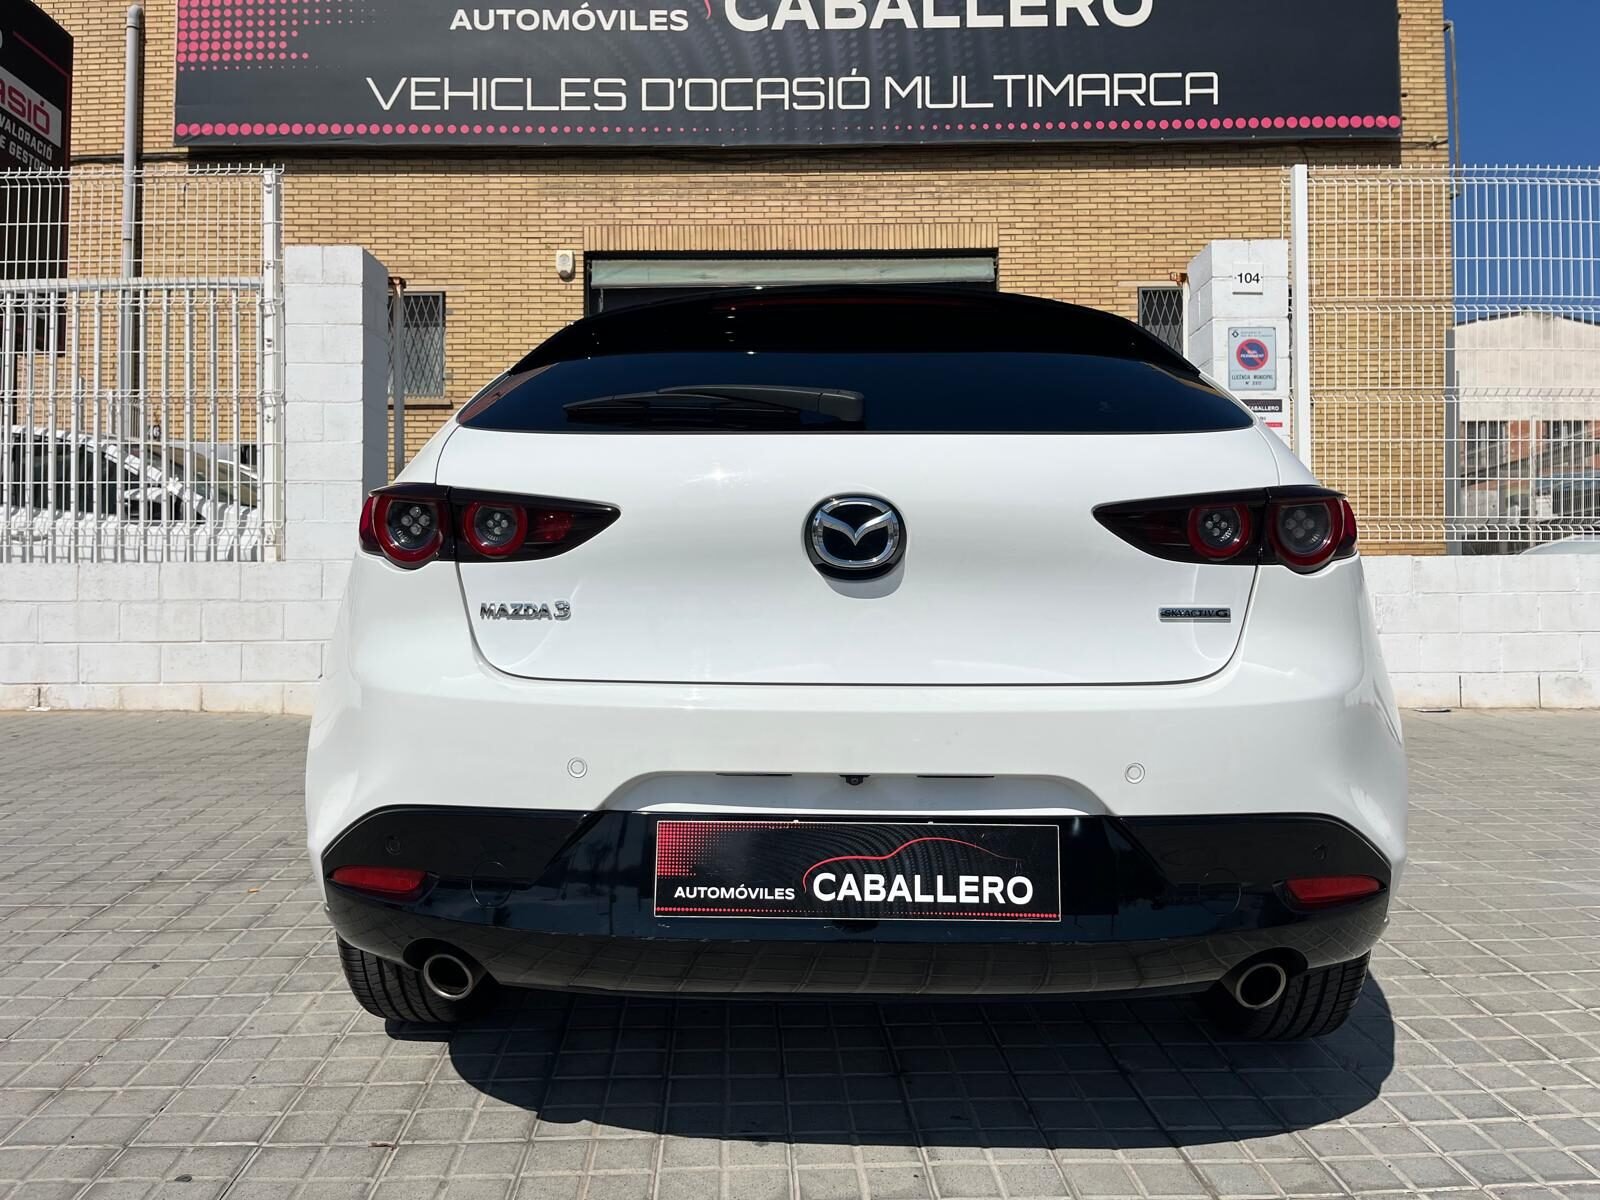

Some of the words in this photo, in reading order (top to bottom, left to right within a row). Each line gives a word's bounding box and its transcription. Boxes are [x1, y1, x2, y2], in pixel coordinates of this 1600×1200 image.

[450, 2, 689, 31] AUTOMÓVILES
[366, 77, 627, 111] VEHICLES
[641, 68, 870, 111] D'OCASIÓ
[885, 71, 1218, 109] MULTIMARCA
[1237, 272, 1260, 284] 104
[674, 884, 795, 900] AUTOMÓVILES
[812, 872, 1034, 904] CABALLERO
